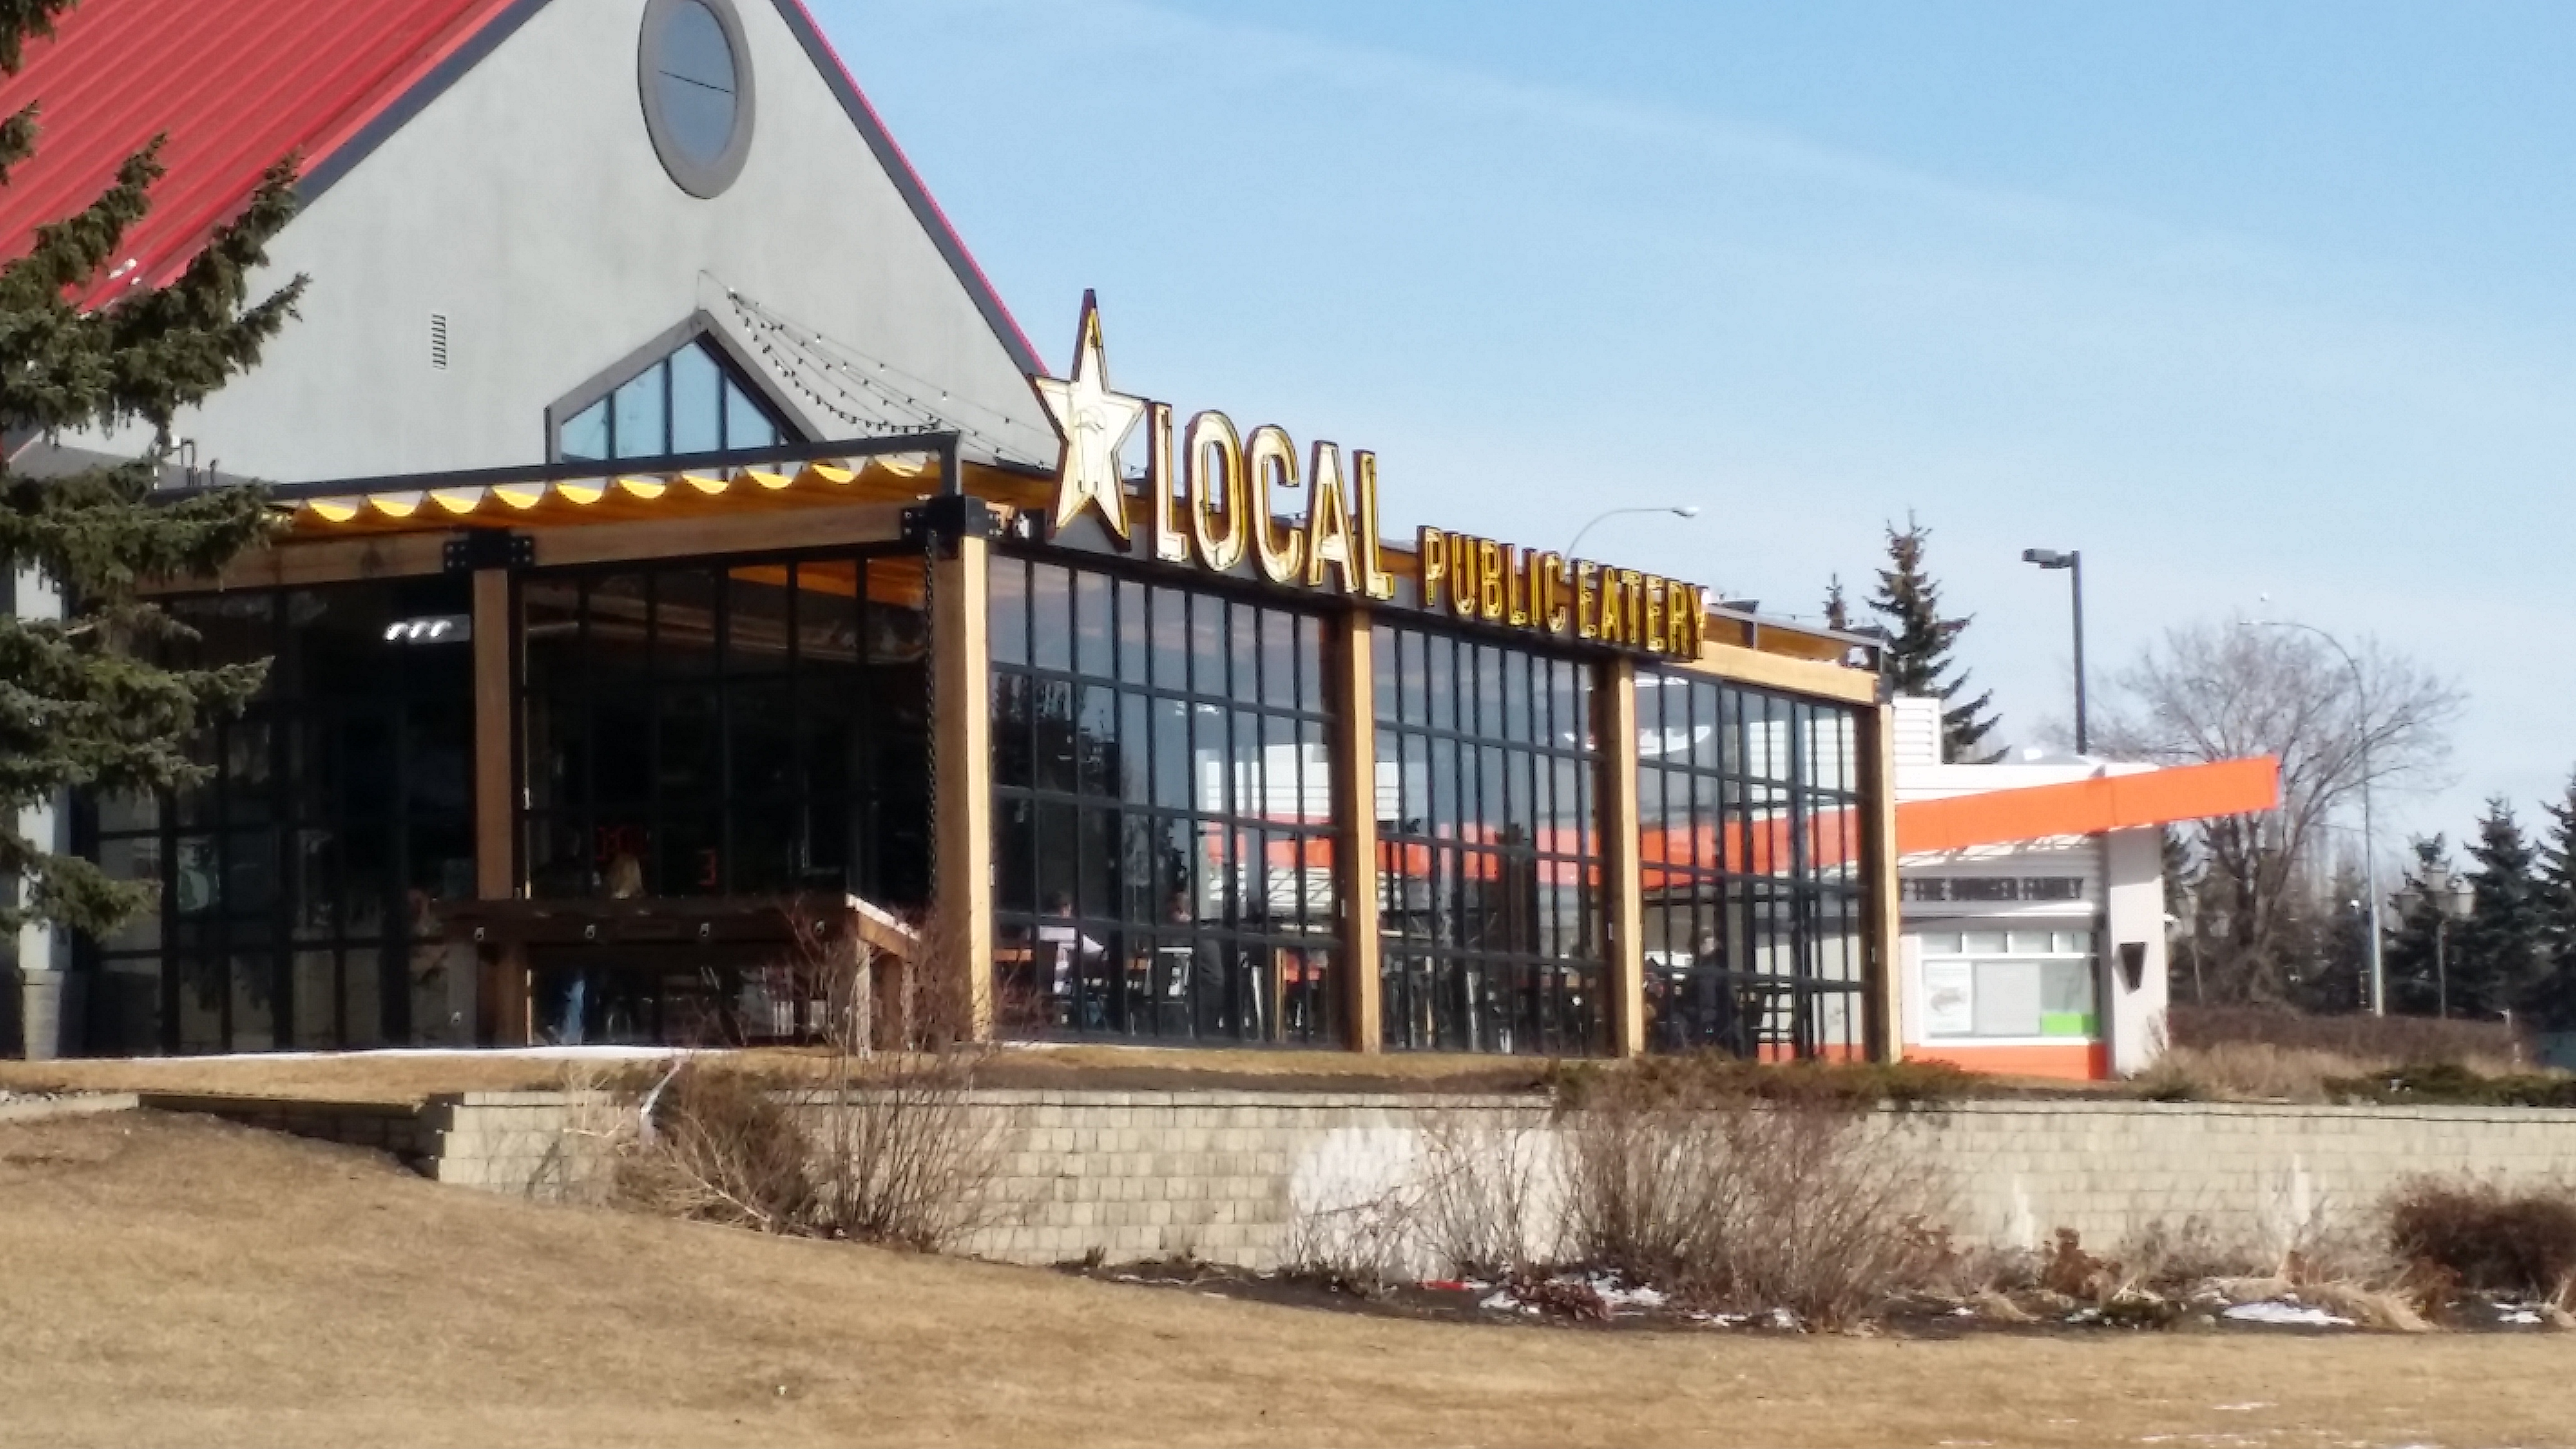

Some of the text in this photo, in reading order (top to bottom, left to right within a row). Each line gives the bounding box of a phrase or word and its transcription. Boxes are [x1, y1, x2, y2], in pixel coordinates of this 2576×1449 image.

[1148, 402, 1708, 661] LOCAL PUBLIC EATERY
